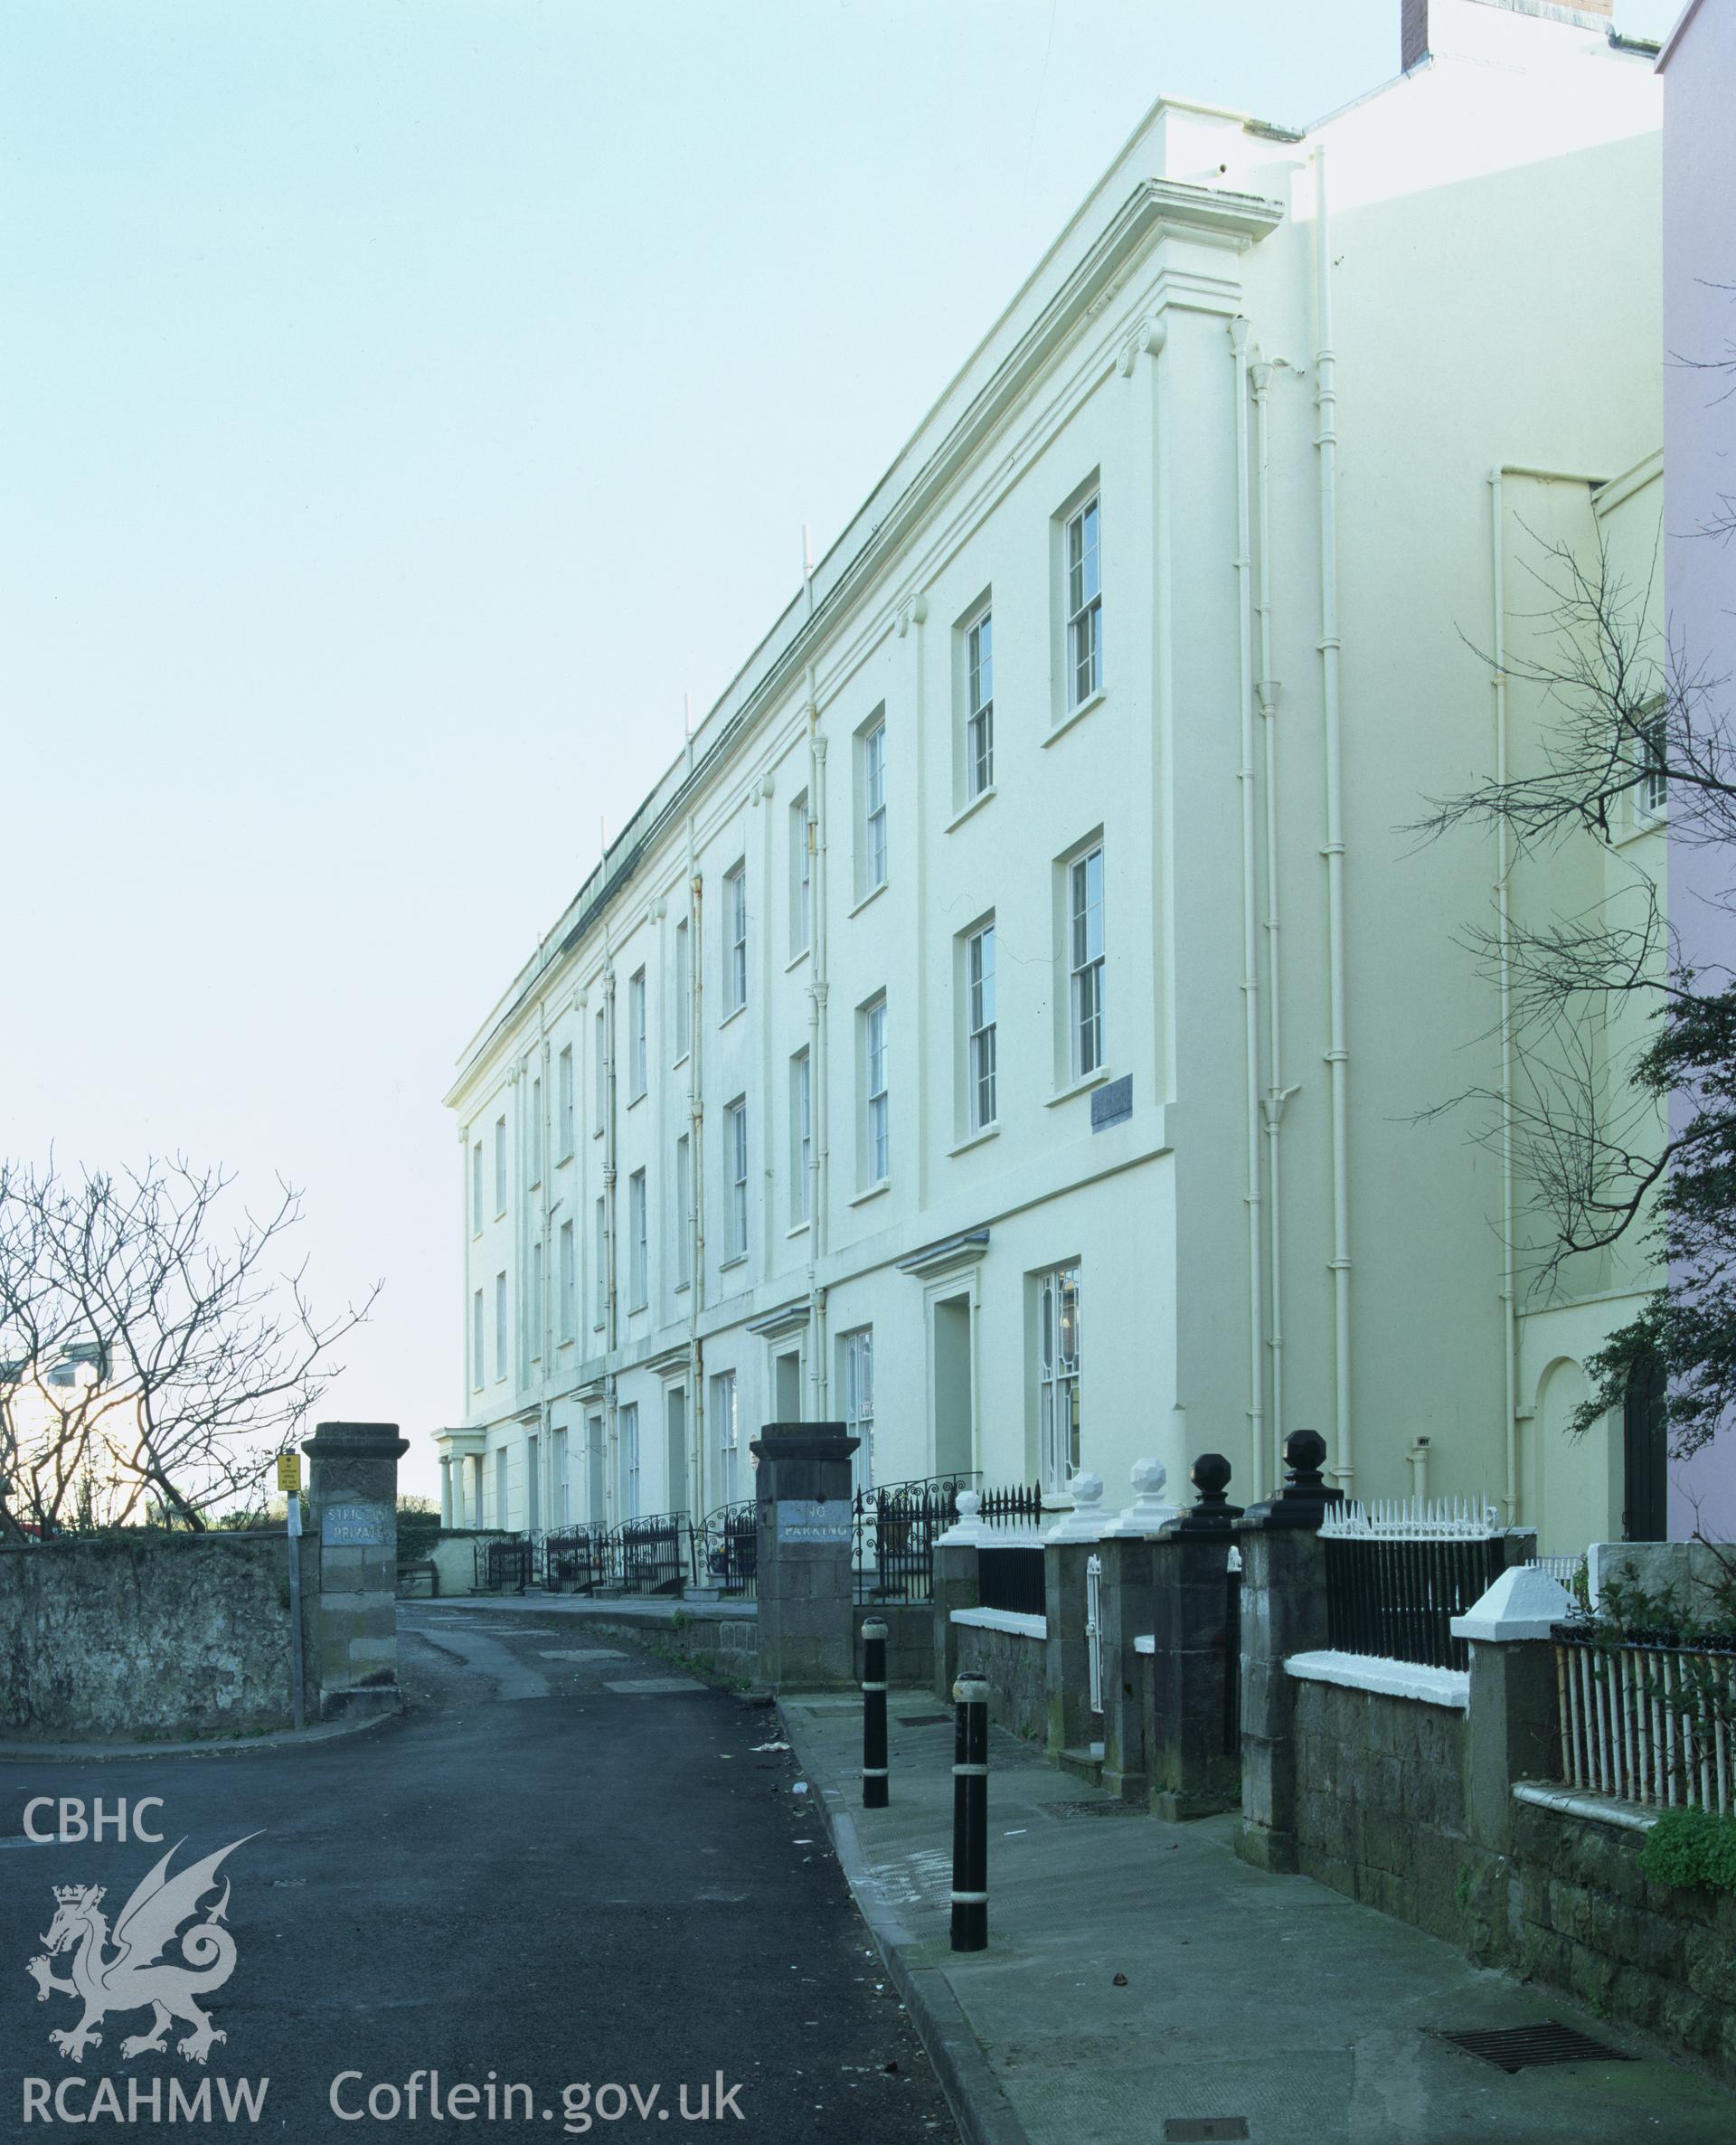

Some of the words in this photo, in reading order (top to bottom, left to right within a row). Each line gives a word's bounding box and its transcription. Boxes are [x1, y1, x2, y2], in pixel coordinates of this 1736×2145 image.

[809, 1505, 826, 1518] NO
[334, 1526, 383, 1539] PRIVATE
[785, 1525, 847, 1536] PARKING
